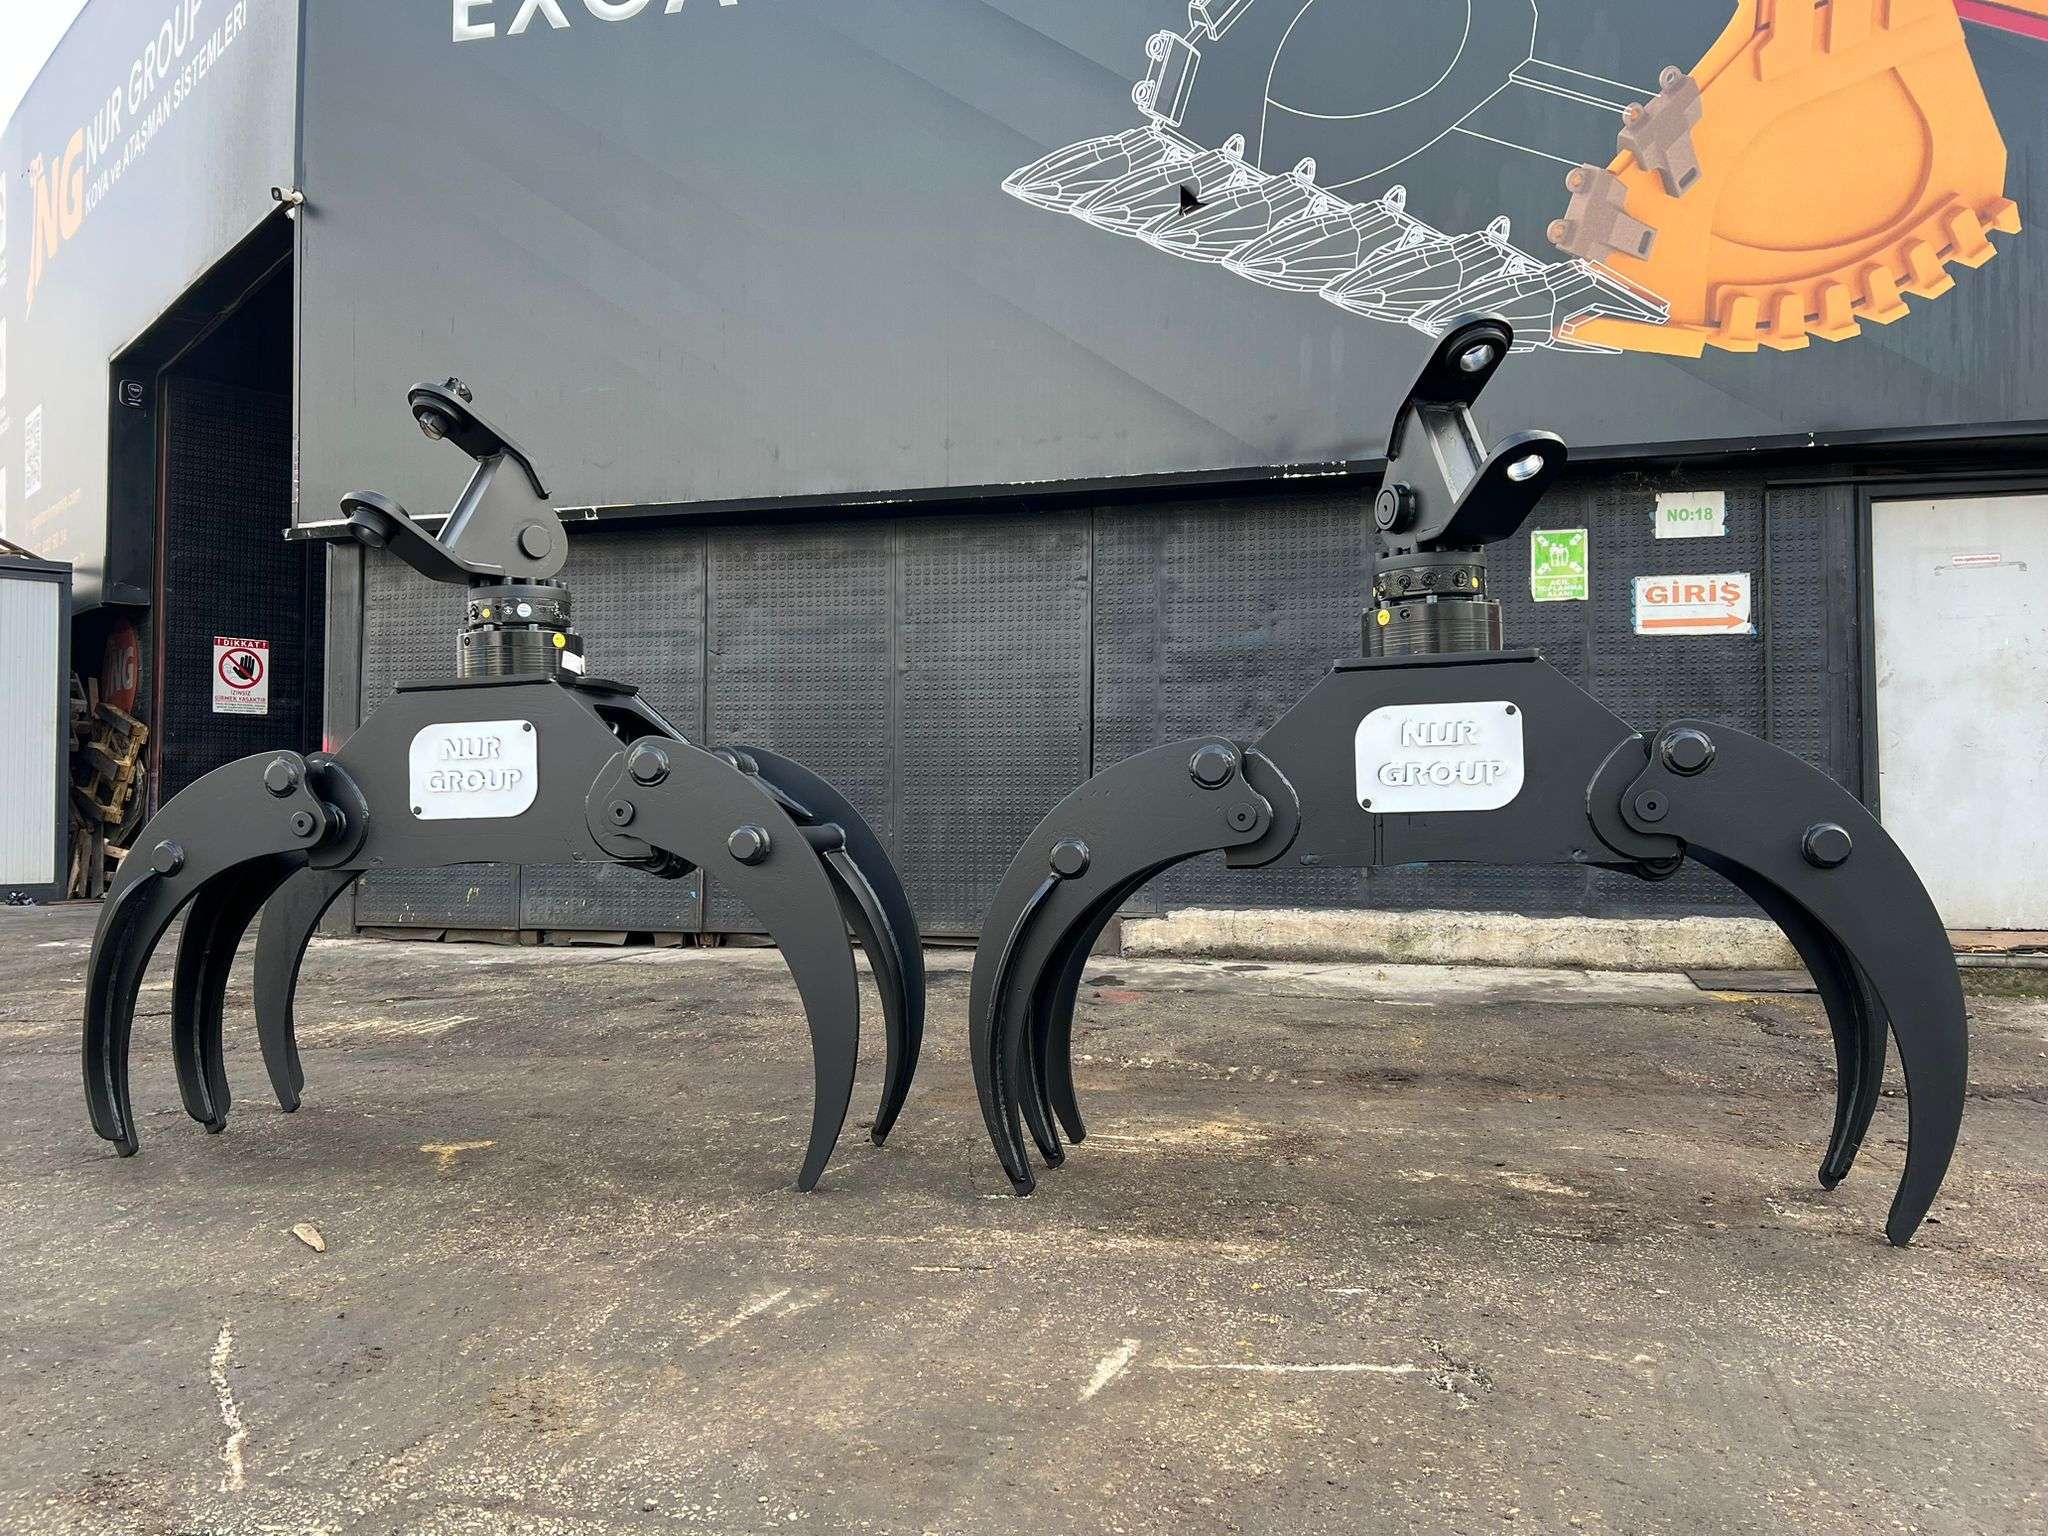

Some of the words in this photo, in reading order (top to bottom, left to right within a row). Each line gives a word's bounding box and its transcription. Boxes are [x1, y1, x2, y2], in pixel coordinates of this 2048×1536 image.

[86, 85, 122, 173] NUR
[127, 0, 201, 115] GROUP
[122, 90, 171, 174] ATAŞMAN
[1666, 507, 1714, 522] NO:18
[1645, 580, 1742, 607] GİRİŞ
[1400, 719, 1481, 748] NUR
[441, 736, 502, 760] NUR
[426, 768, 524, 793] GROUP
[1377, 760, 1508, 788] GROUP
